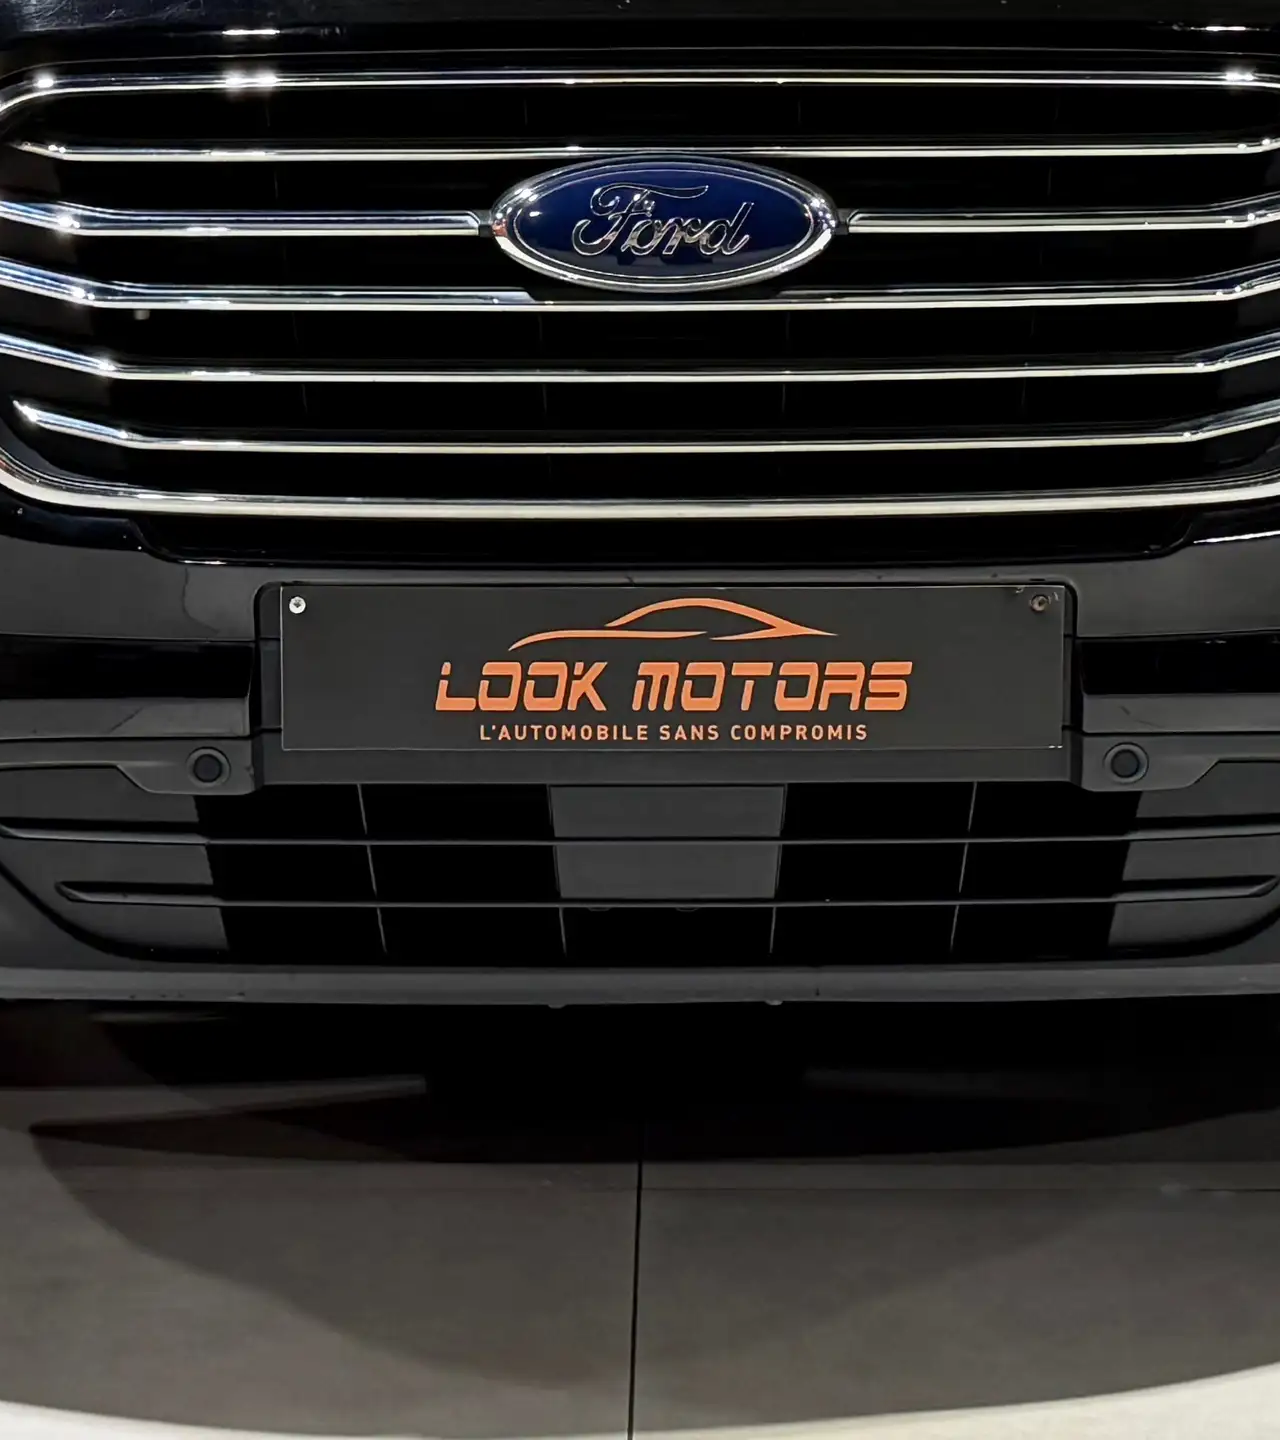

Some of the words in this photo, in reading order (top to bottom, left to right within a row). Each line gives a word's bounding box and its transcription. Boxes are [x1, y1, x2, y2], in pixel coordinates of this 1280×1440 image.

[573, 182, 754, 256] Ford
[435, 661, 608, 712] LOOK
[631, 661, 913, 712] MOTORS
[479, 724, 649, 742] L'AUTOMOBILE
[659, 724, 720, 742] SANS
[730, 724, 868, 742] COMPROMIS
